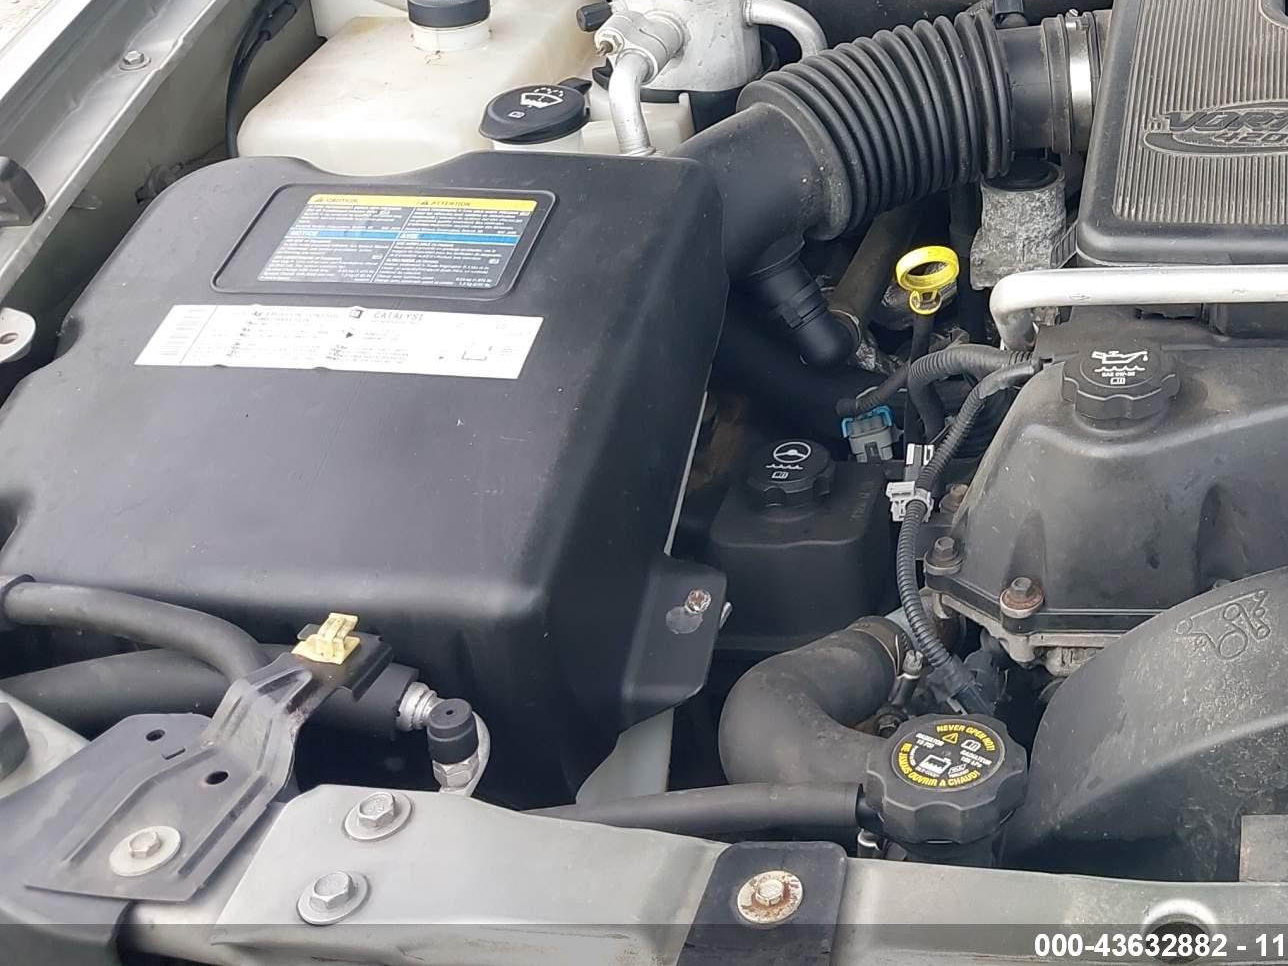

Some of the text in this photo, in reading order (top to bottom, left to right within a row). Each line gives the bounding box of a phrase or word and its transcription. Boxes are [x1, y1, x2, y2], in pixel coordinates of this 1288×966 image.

[373, 311, 424, 322] CATALYST
[936, 724, 966, 733] NEVER
[966, 728, 987, 739] OPEN
[907, 771, 938, 787] OUVRIR
